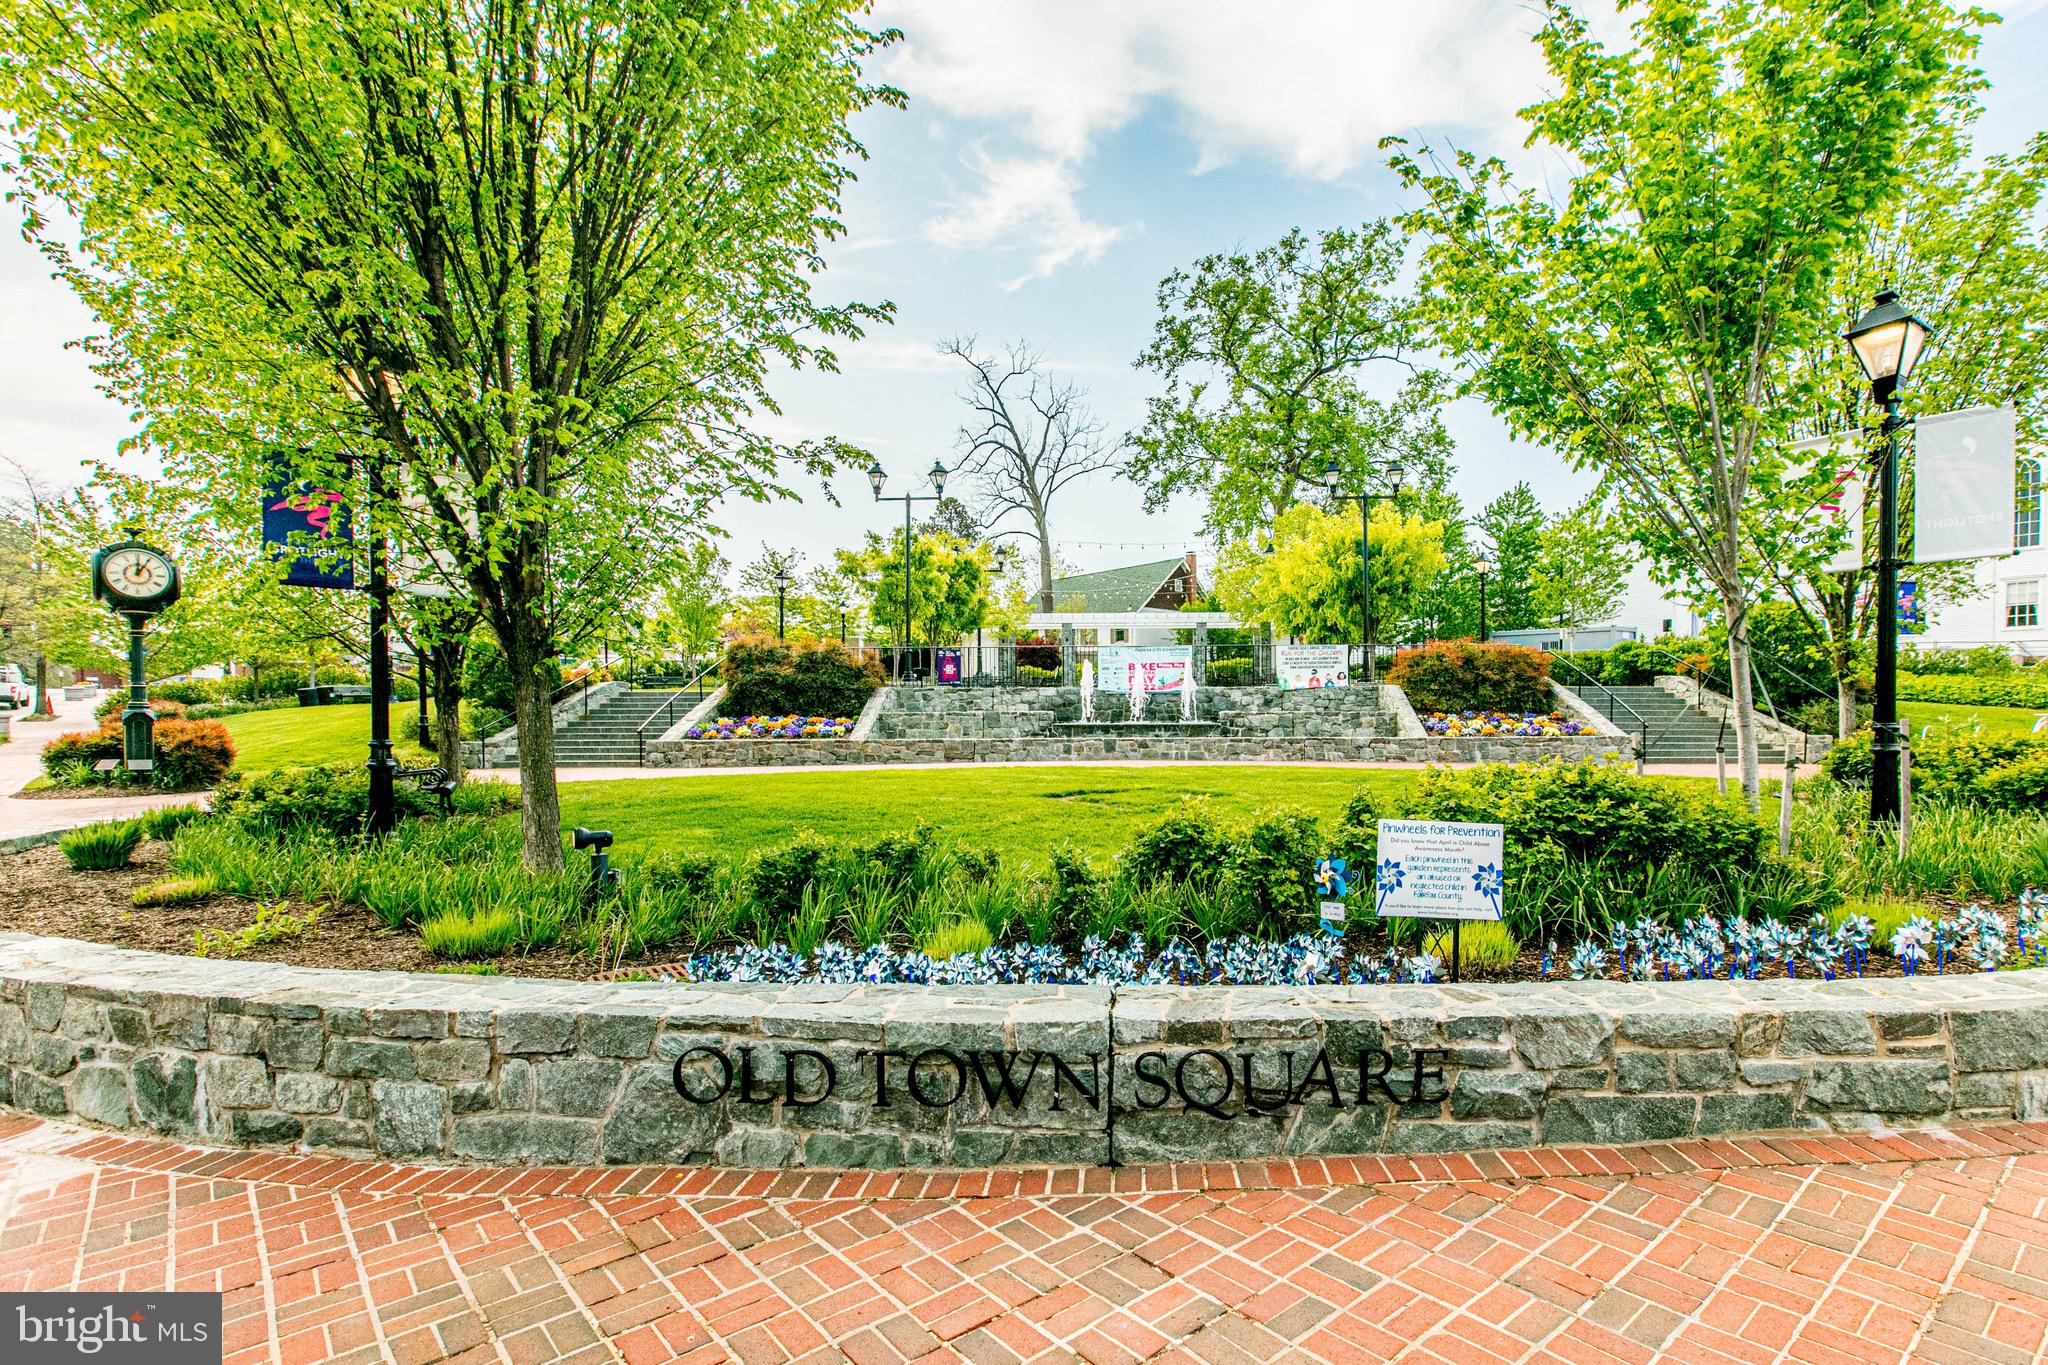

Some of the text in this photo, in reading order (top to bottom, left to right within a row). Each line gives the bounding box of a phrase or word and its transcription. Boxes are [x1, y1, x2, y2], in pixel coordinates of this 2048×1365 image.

[1128, 662, 1156, 670] BKE
[1382, 822, 1428, 835] Pinwheels
[1447, 825, 1501, 838] Prevention
[1405, 854, 1422, 862] Each
[1423, 856, 1452, 864] pinwheel
[1407, 864, 1471, 874] garden represents
[1410, 882, 1444, 892] neglected
[1413, 890, 1436, 898] Fairfax
[672, 1046, 1450, 1121] OLD TOWN SQUARE
